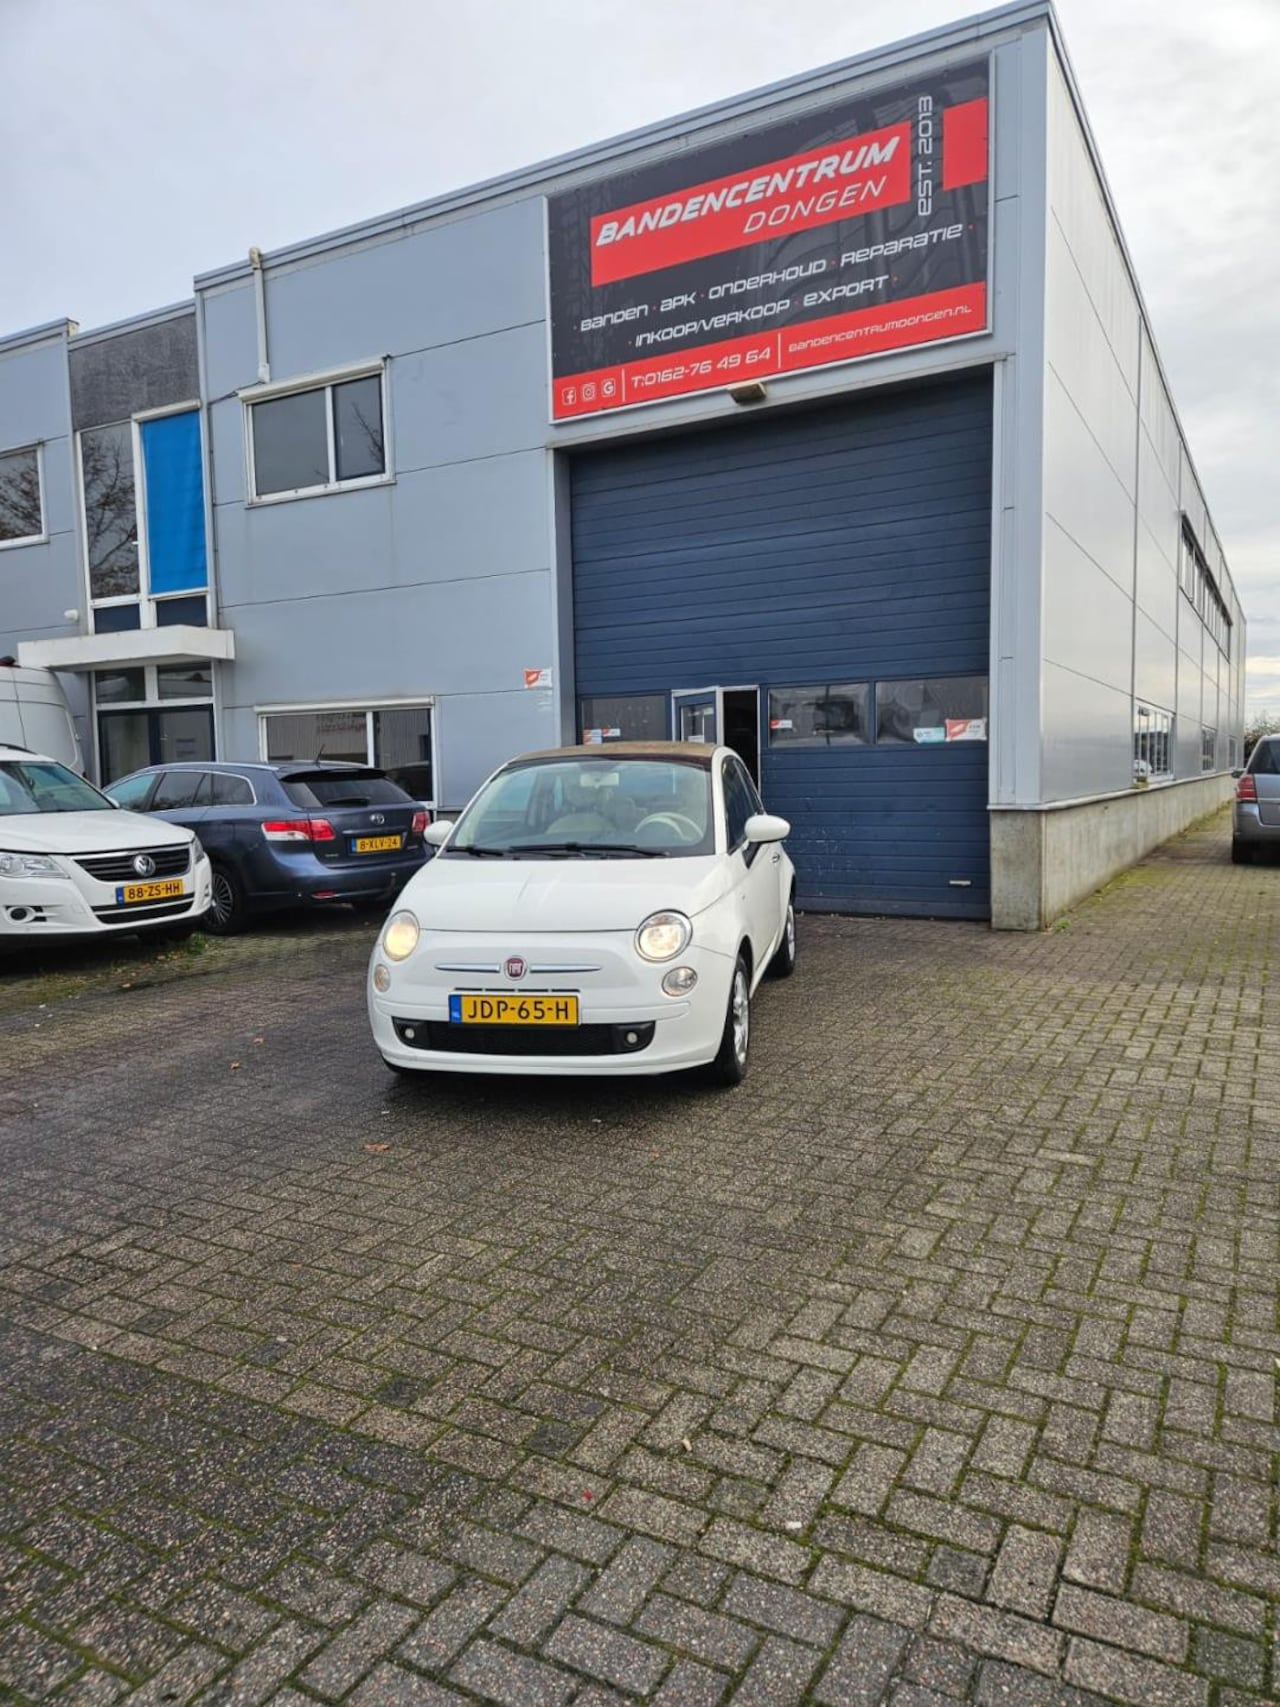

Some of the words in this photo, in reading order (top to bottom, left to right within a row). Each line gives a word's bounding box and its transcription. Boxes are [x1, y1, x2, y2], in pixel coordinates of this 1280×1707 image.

[917, 96, 932, 154] 2013
[595, 136, 899, 246] BANDENCENTRUM
[743, 176, 886, 233] DONGEN
[717, 353, 741, 370] 49
[745, 347, 771, 364] 64
[128, 882, 180, 899] 88-ZS-HH
[468, 1000, 569, 1019] JDP-65-H
